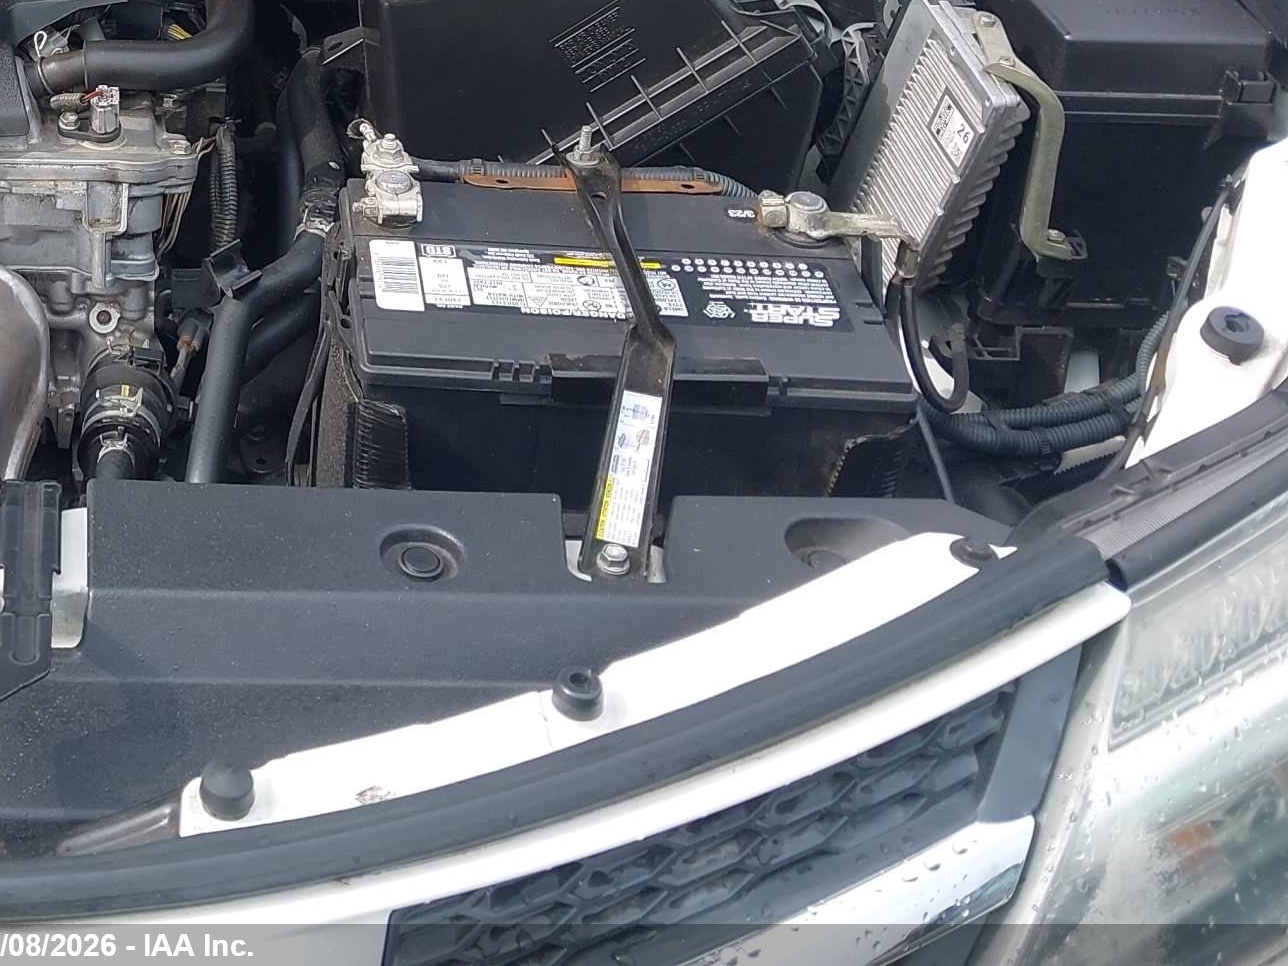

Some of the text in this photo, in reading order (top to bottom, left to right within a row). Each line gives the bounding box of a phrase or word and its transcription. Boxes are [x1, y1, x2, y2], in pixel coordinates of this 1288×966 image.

[957, 123, 970, 144] 26
[727, 209, 756, 218] 3/23
[753, 304, 840, 320] START
[751, 313, 834, 327] SUPER
